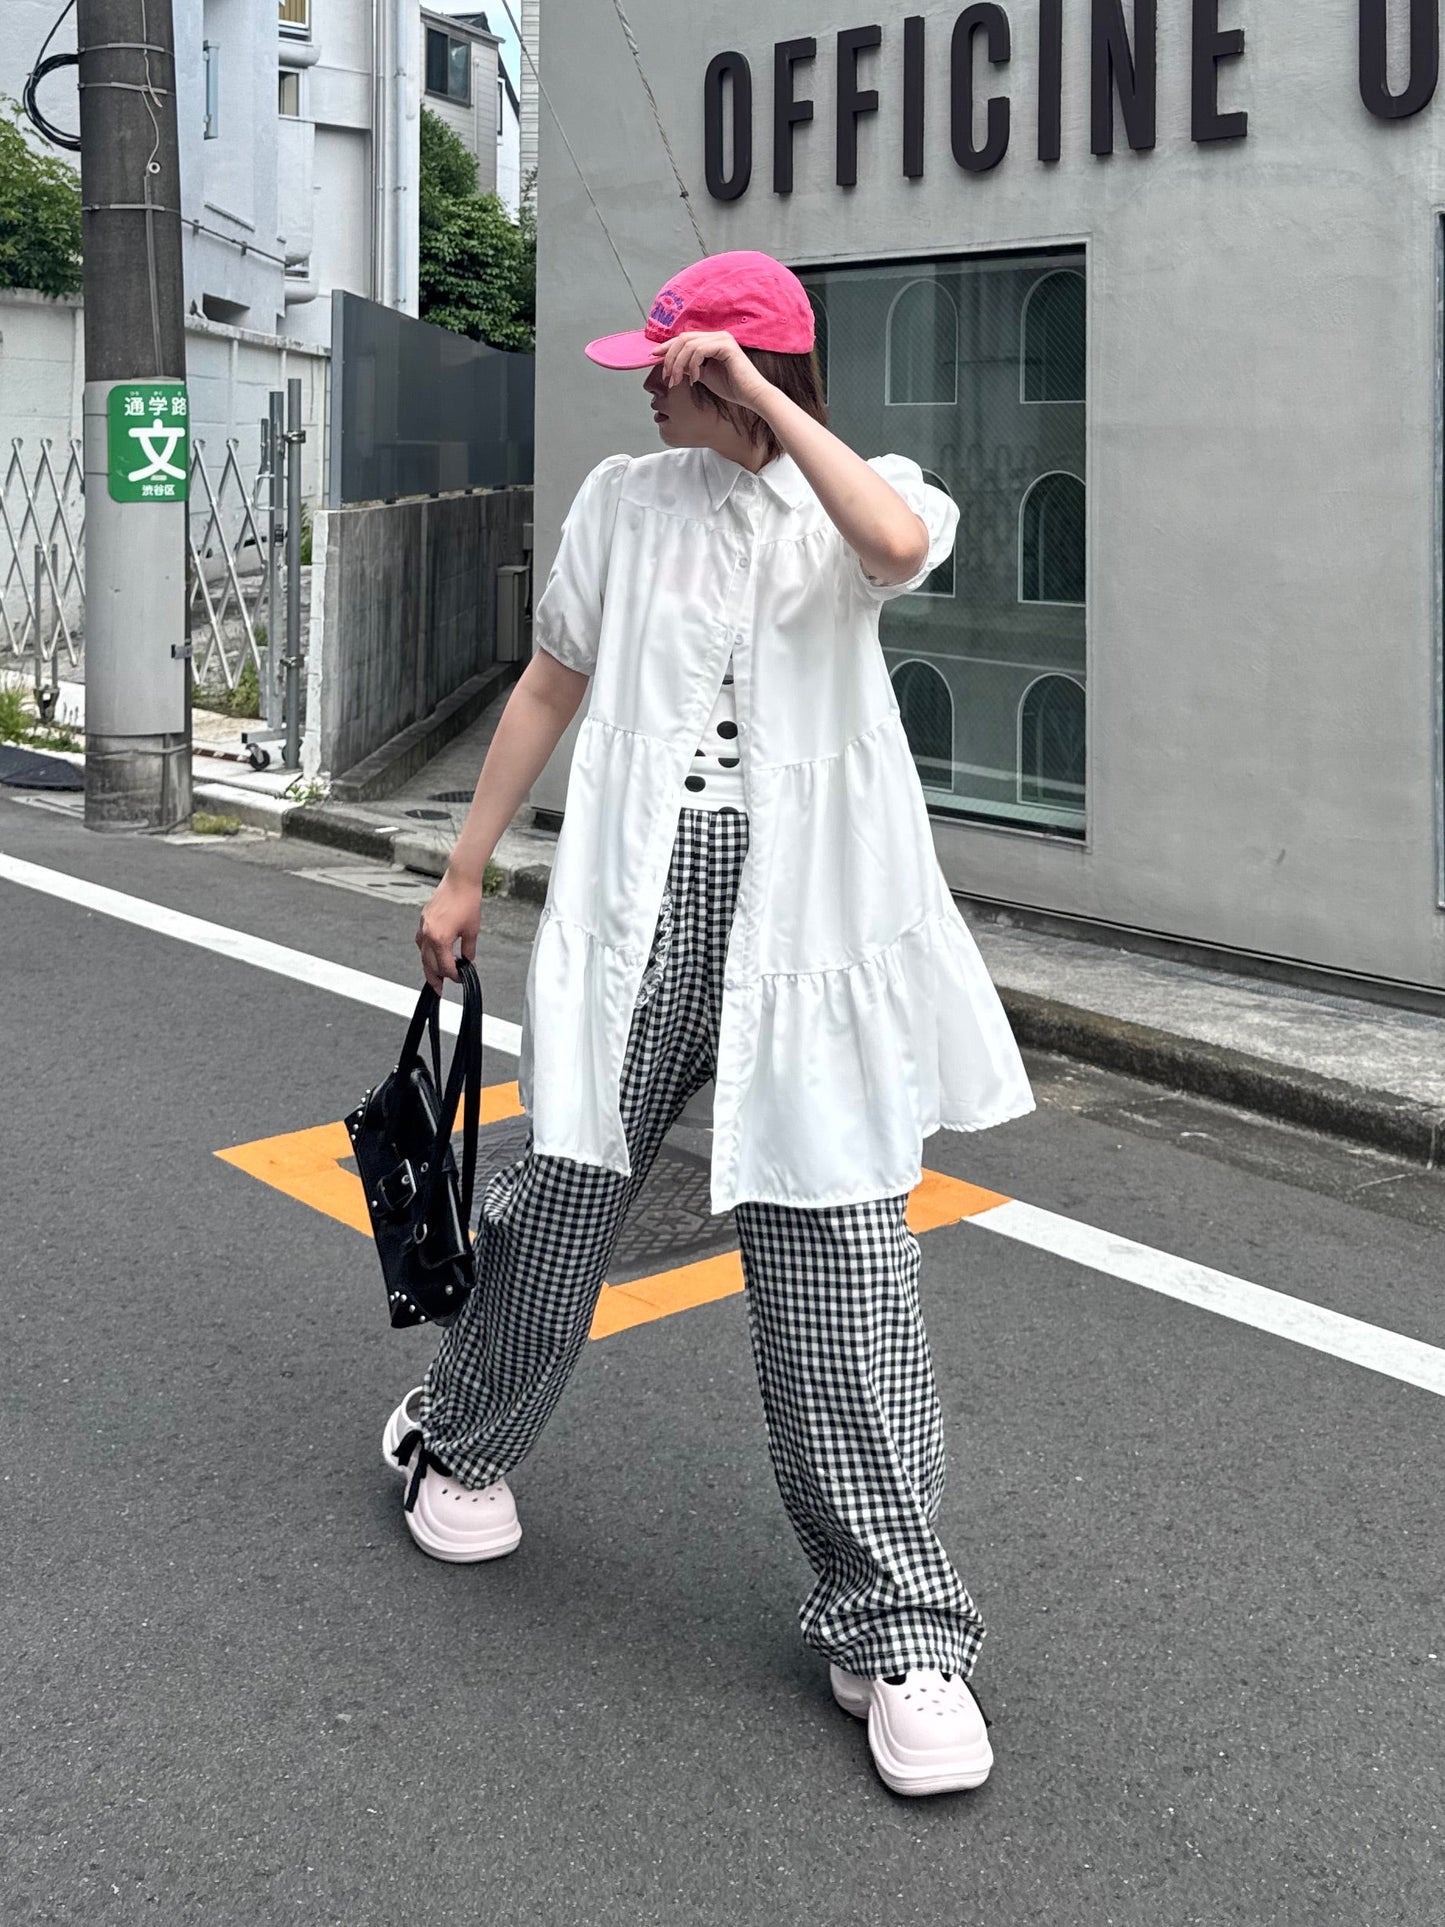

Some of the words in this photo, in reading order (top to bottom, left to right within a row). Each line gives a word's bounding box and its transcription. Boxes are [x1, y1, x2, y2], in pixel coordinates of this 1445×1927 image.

[704, 0, 1247, 200] OFFICINE
[124, 396, 187, 416] 通学路
[128, 418, 187, 482] 文
[141, 484, 176, 496] 渋谷区
